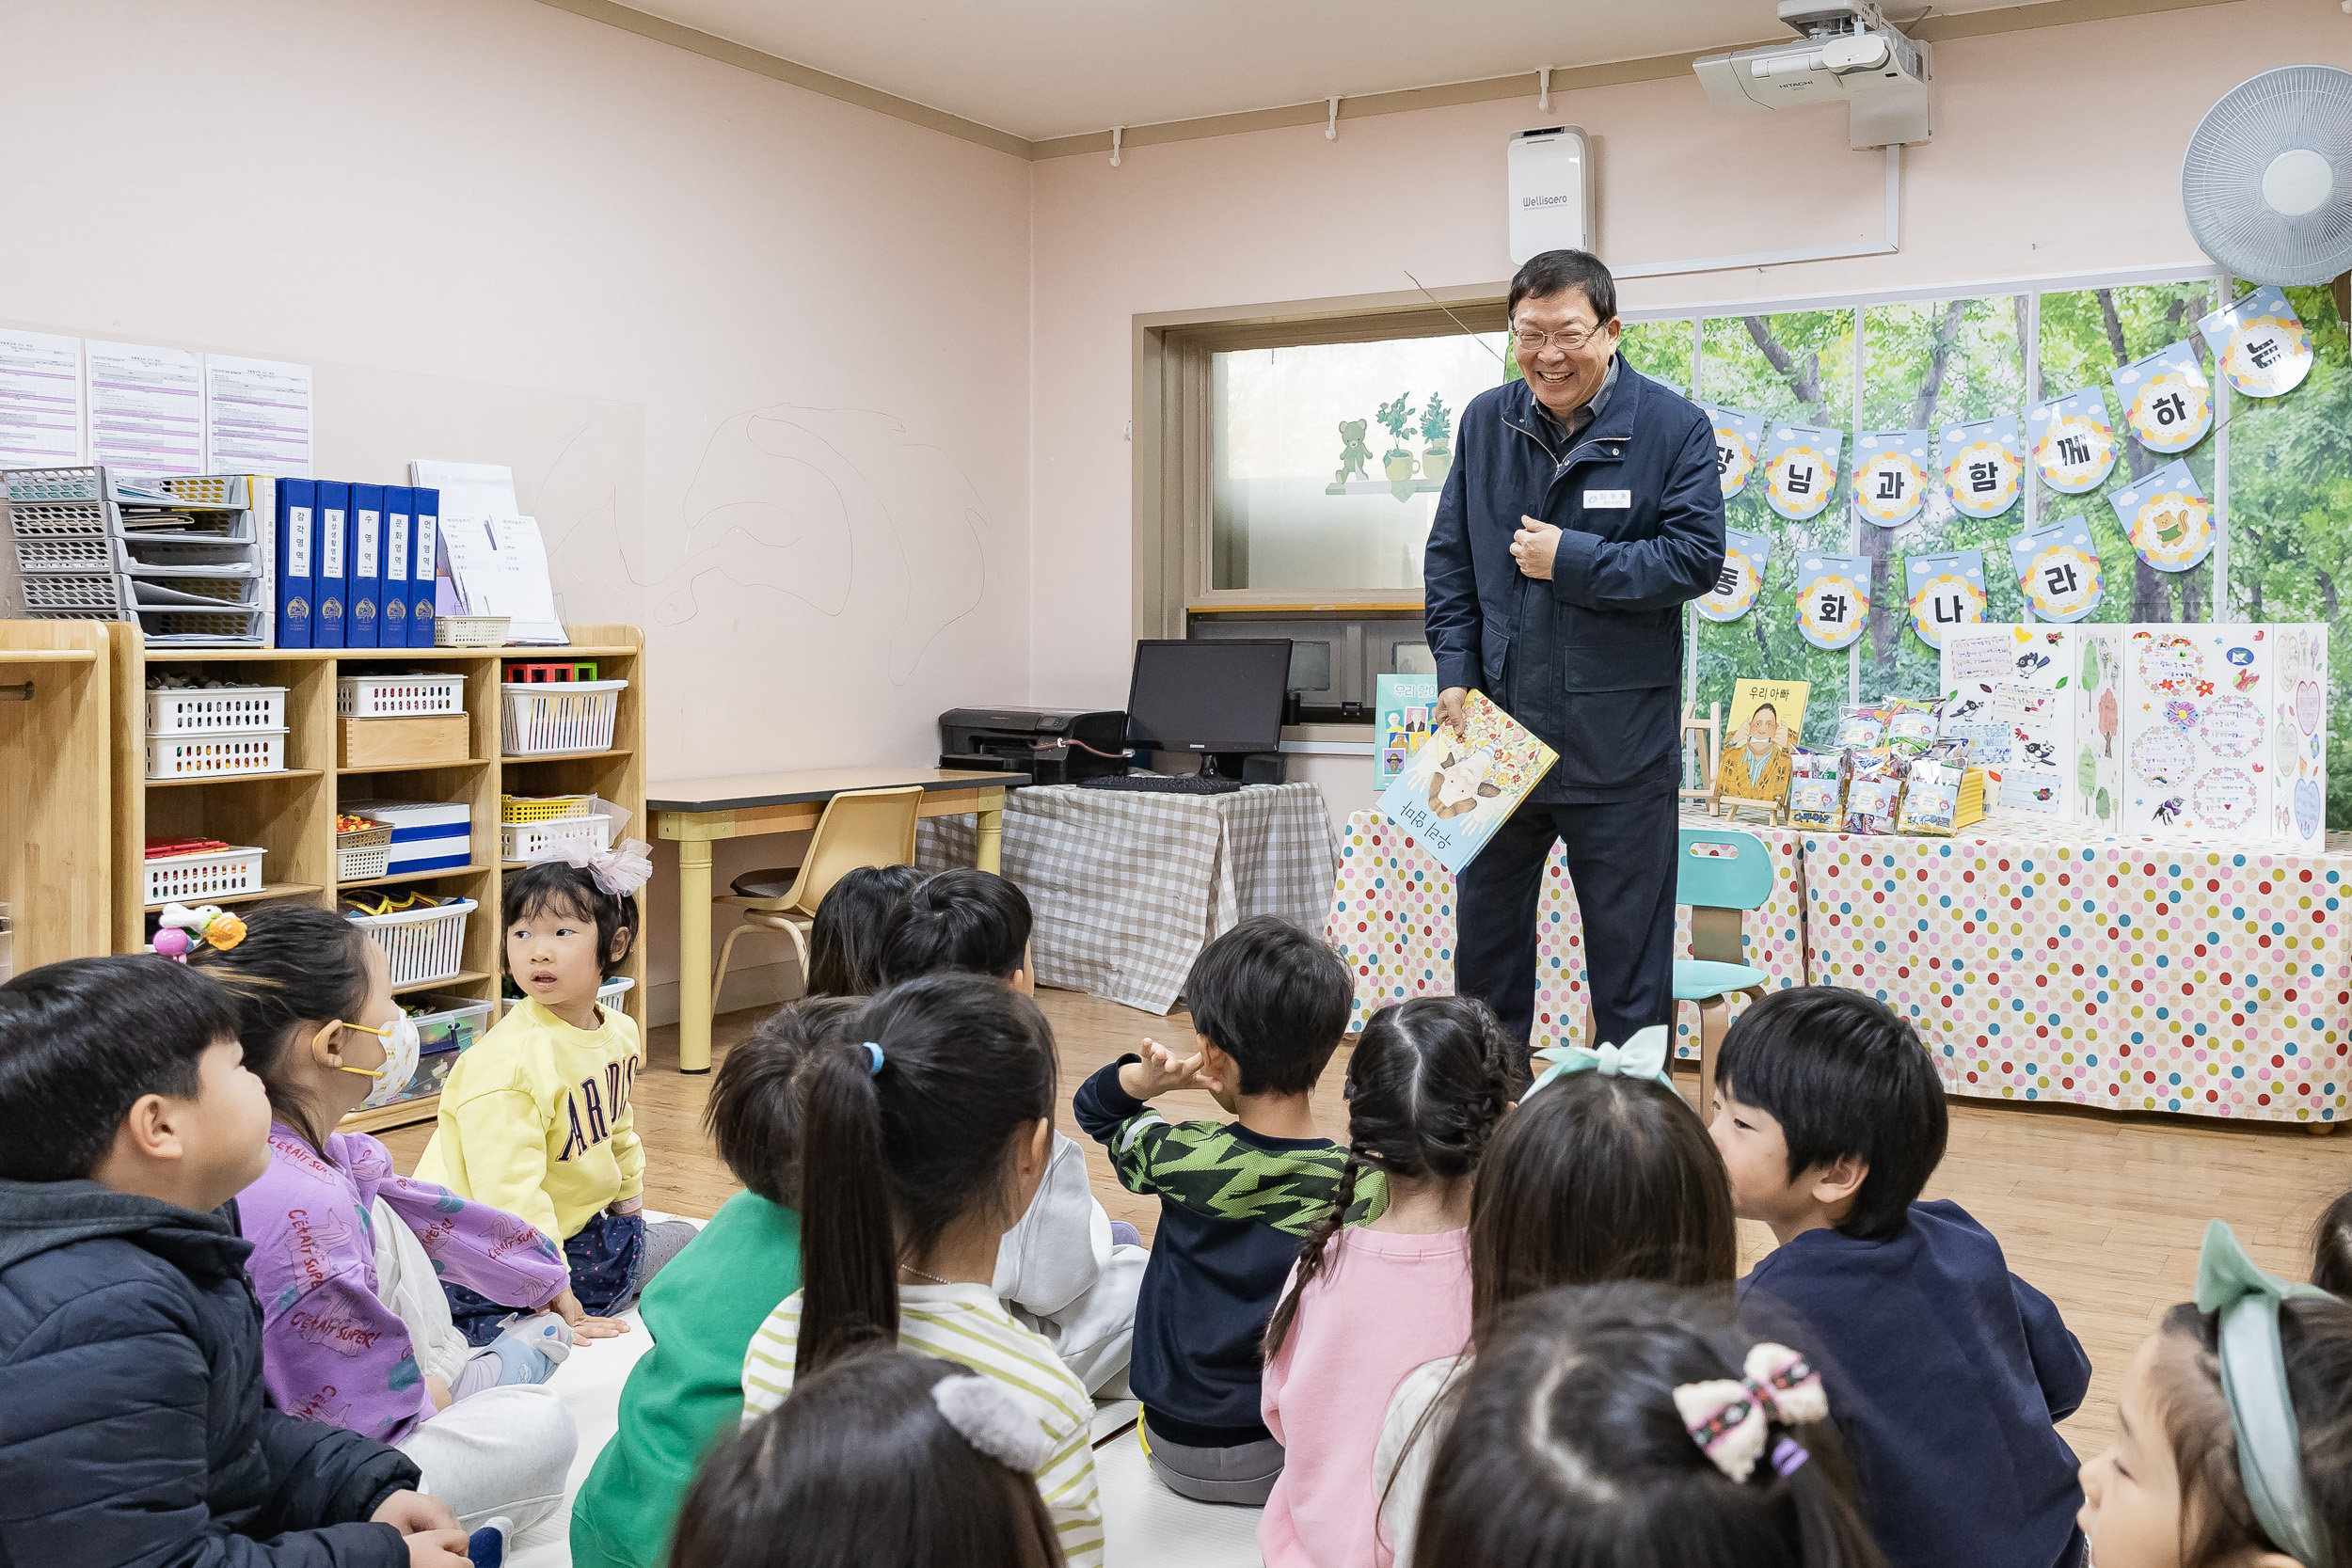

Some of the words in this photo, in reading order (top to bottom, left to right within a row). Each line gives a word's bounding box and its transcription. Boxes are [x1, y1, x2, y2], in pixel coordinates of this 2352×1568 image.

[1778, 80, 1814, 88] HITACHI
[1522, 194, 1568, 207] Wellisaero
[295, 512, 305, 562] 감각영역
[422, 520, 431, 566] 언어영역
[1395, 685, 1415, 697] 우리
[1749, 686, 1769, 701] 우리
[1770, 688, 1790, 702] 아빠
